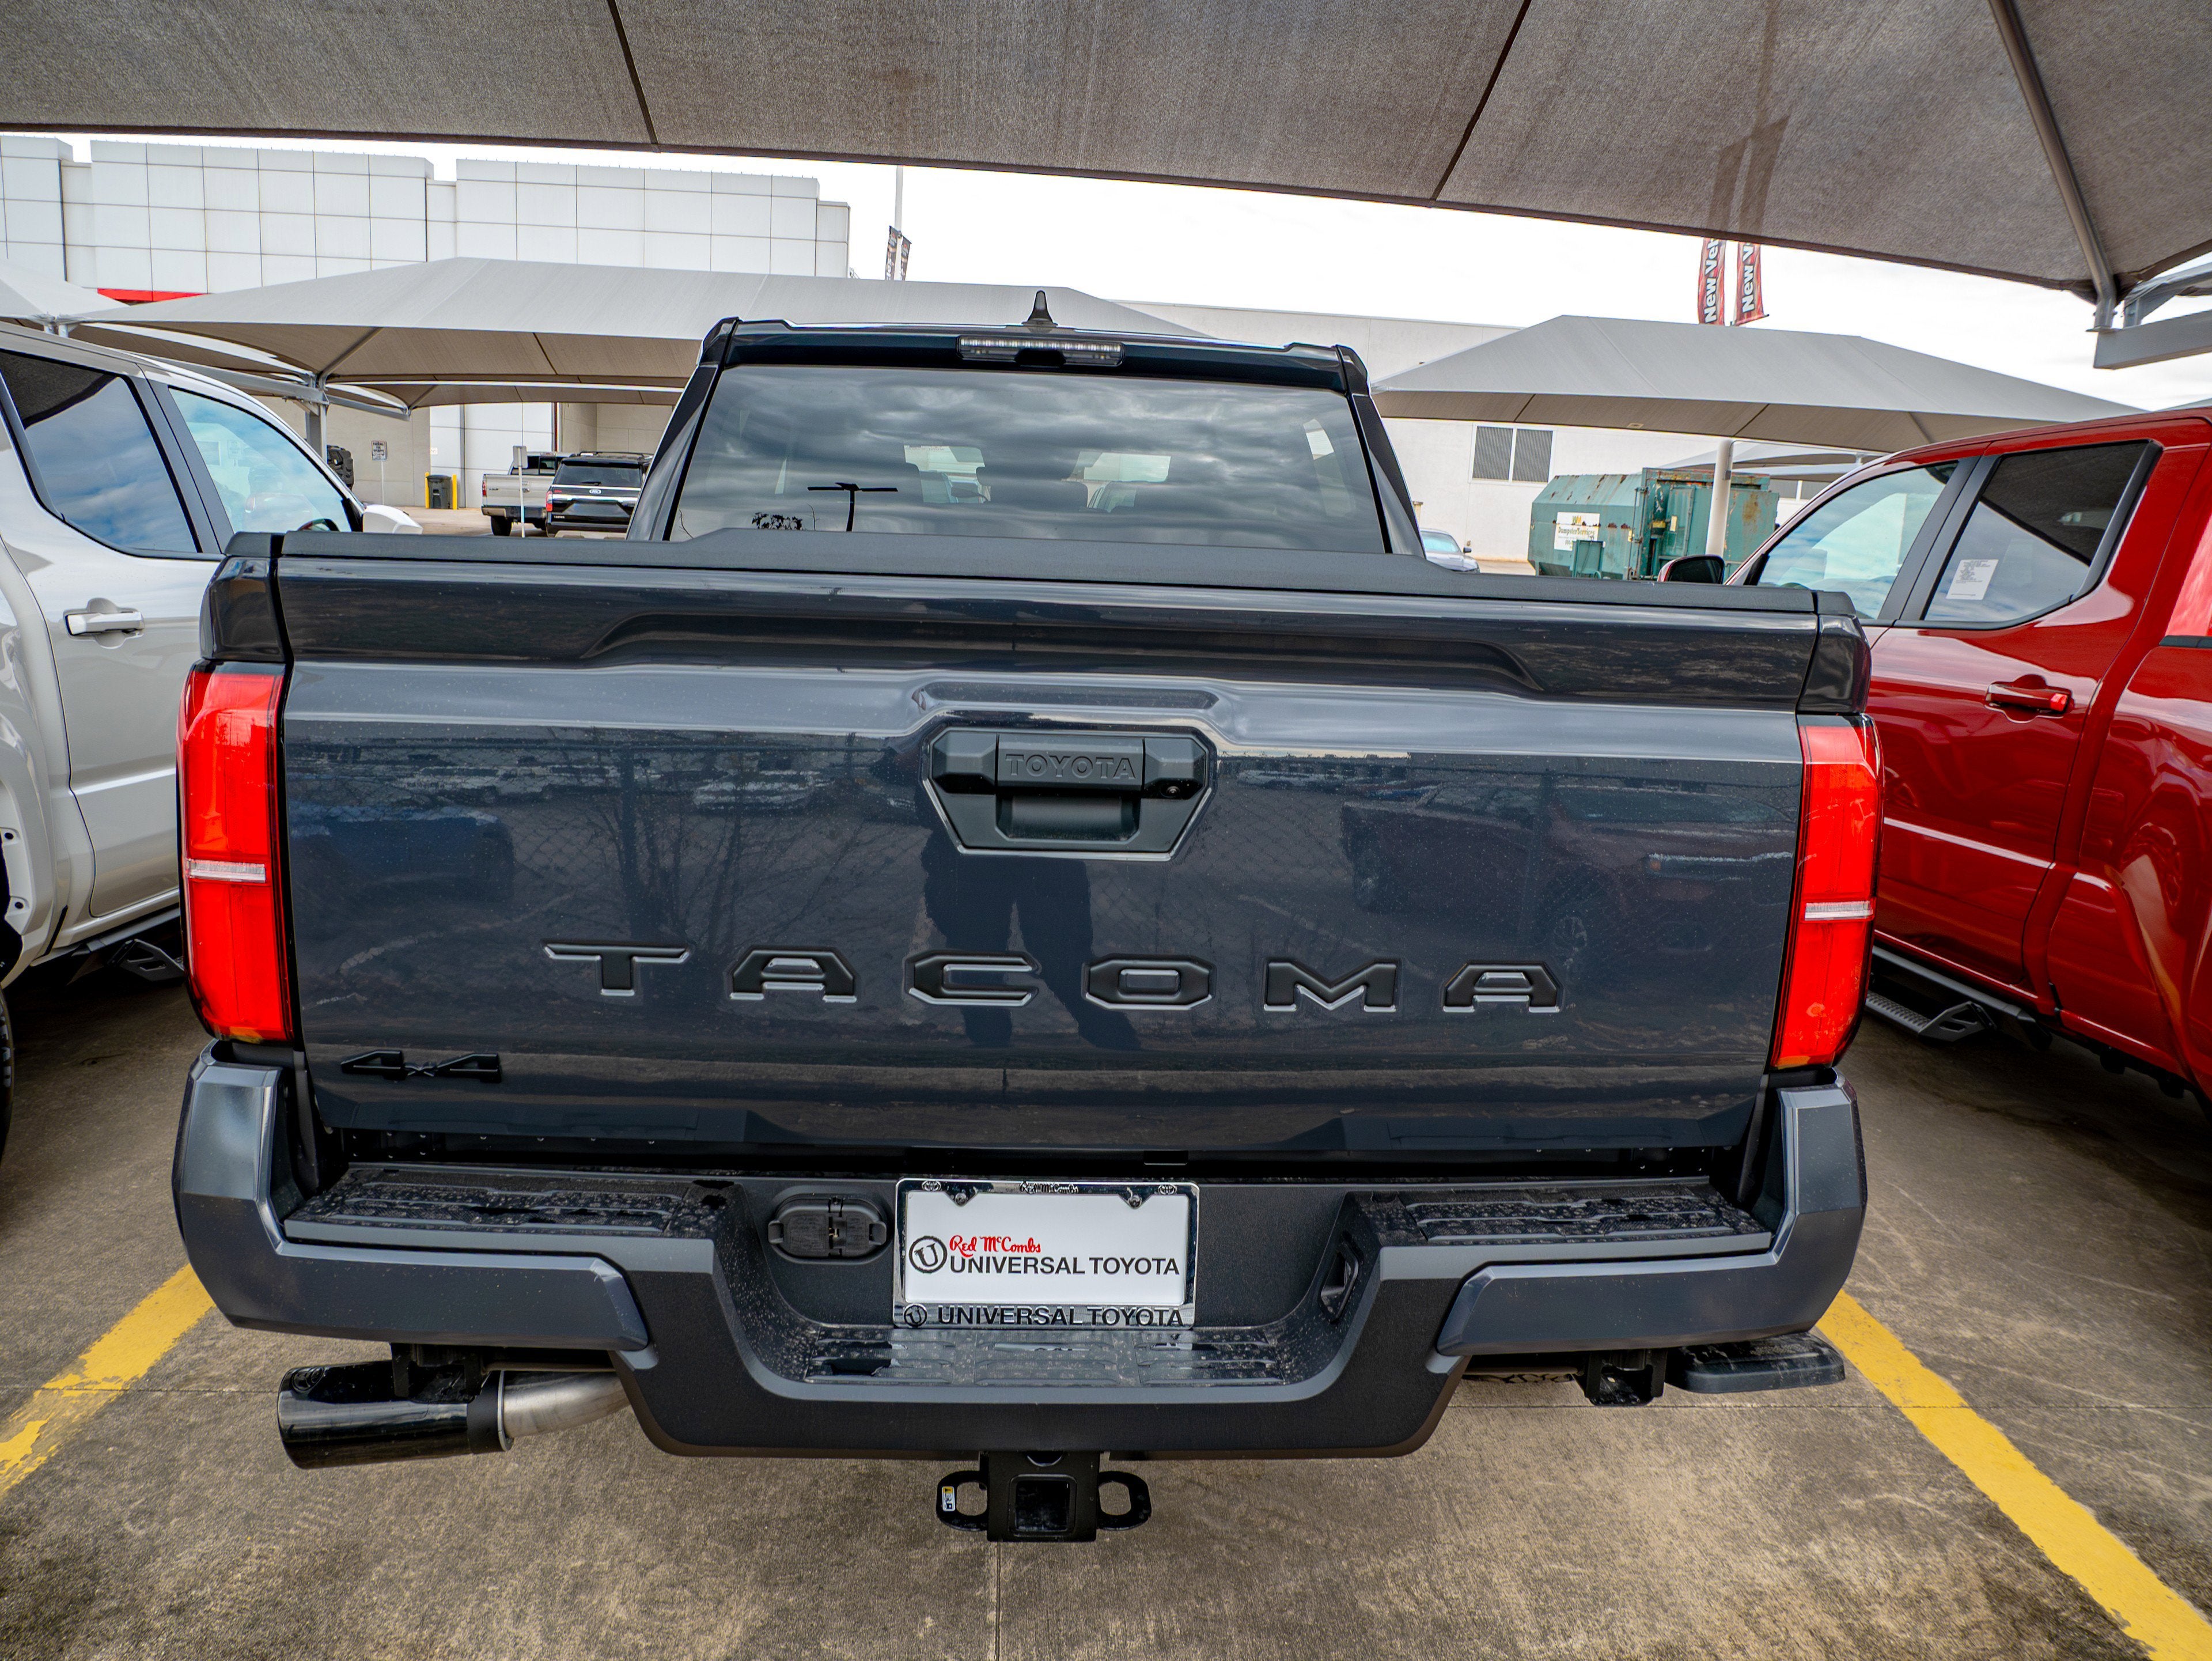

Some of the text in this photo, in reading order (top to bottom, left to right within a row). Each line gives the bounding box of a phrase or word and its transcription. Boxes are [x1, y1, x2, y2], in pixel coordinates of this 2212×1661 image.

[1704, 278, 1717, 323] New
[1741, 265, 1755, 313] New
[1006, 754, 1137, 780] TOYOTA
[541, 940, 1562, 1013] TACOMA
[949, 1235, 1041, 1258] Red McCombs
[950, 1255, 1180, 1275] UNIVERSAL TOYOTA
[938, 1304, 1184, 1326] UNIVERSAL TOYOTA
